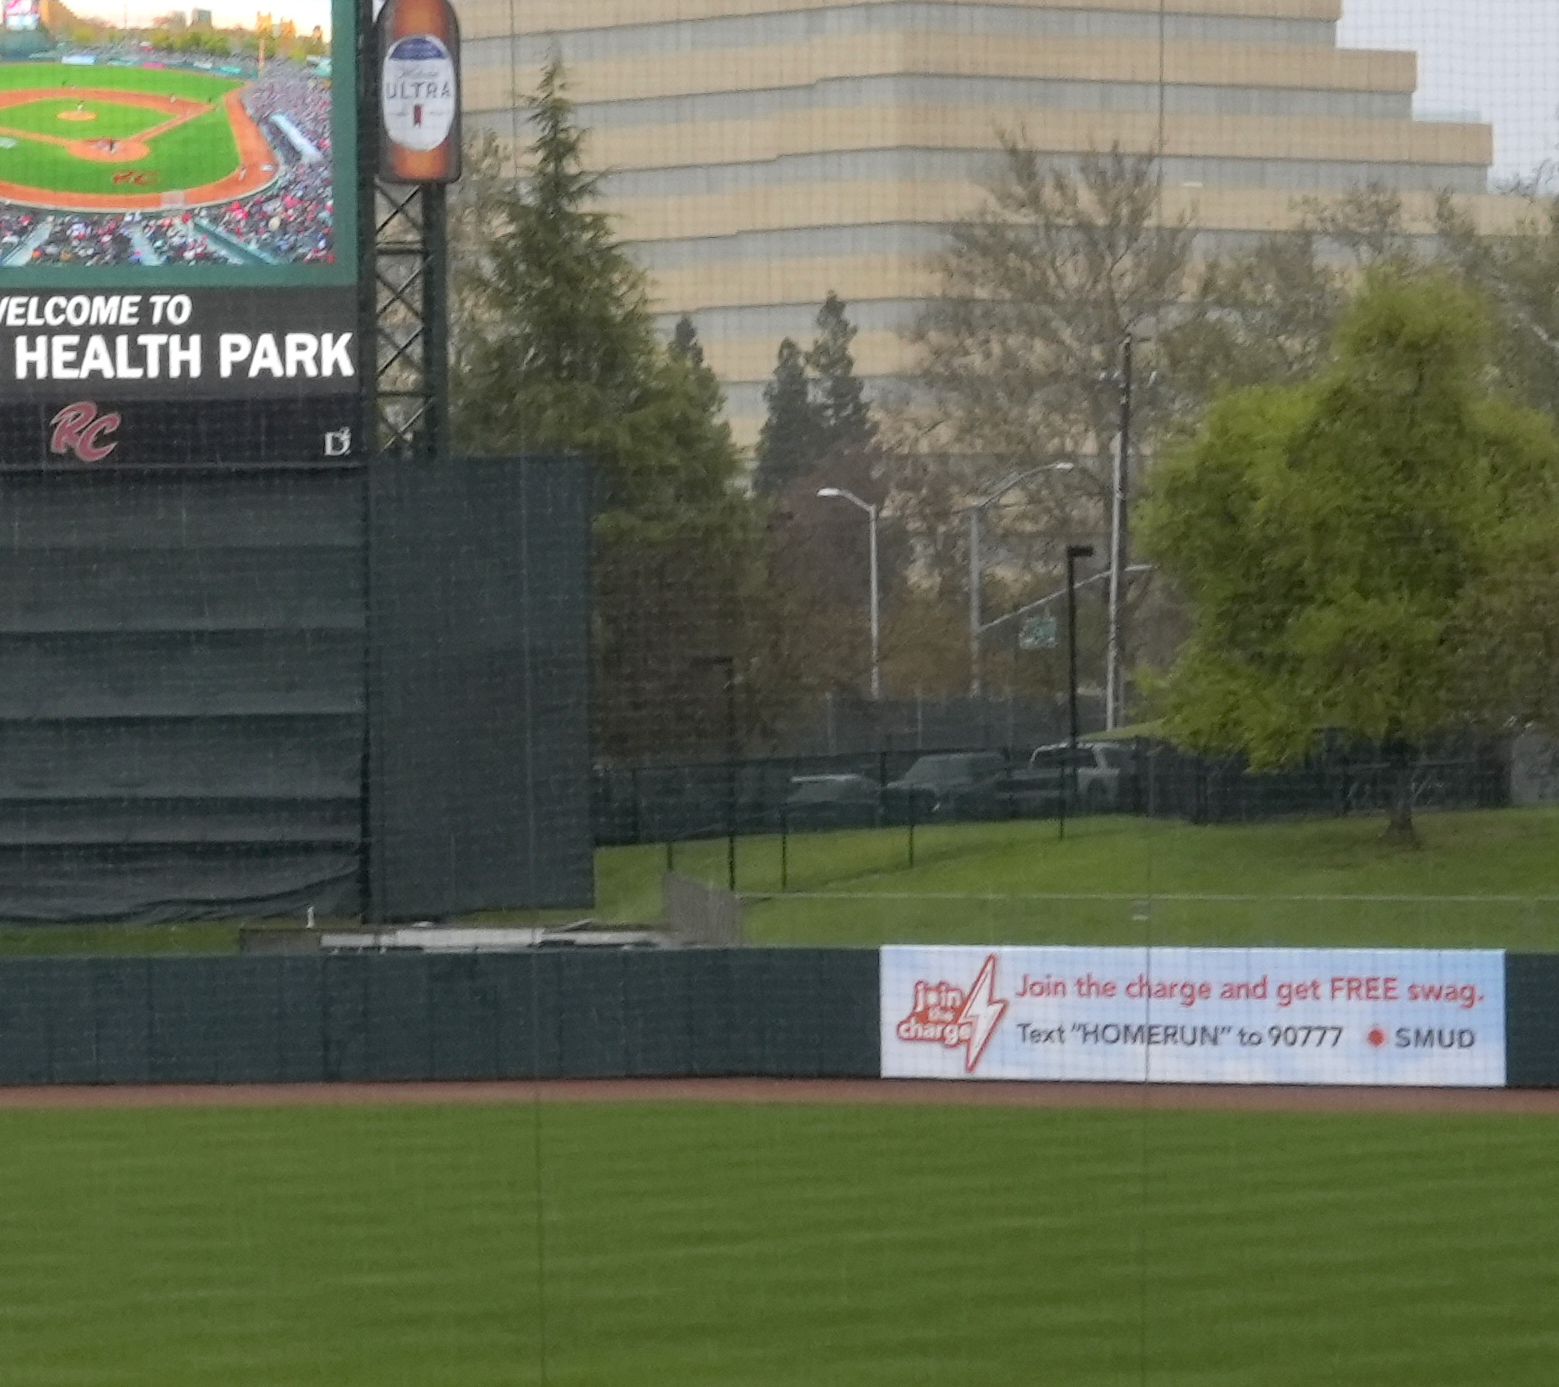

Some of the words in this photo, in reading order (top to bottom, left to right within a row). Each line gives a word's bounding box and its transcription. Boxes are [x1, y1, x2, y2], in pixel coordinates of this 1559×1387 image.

[386, 81, 450, 99] ULTRA
[149, 295, 192, 325] TO
[15, 334, 201, 379] HEALTH
[220, 332, 355, 378] PARK
[1016, 974, 1067, 998] Join
[1077, 974, 1116, 998] the
[1125, 974, 1211, 1007] charge
[1220, 975, 1268, 1000] and
[1276, 979, 1321, 1007] get
[1330, 977, 1399, 1000] FREE
[1408, 983, 1484, 1009] swag.
[1017, 1023, 1064, 1044] Text
[1237, 1026, 1262, 1046] to
[1268, 1025, 1343, 1047] 90777
[1395, 1026, 1476, 1048] SMUD
